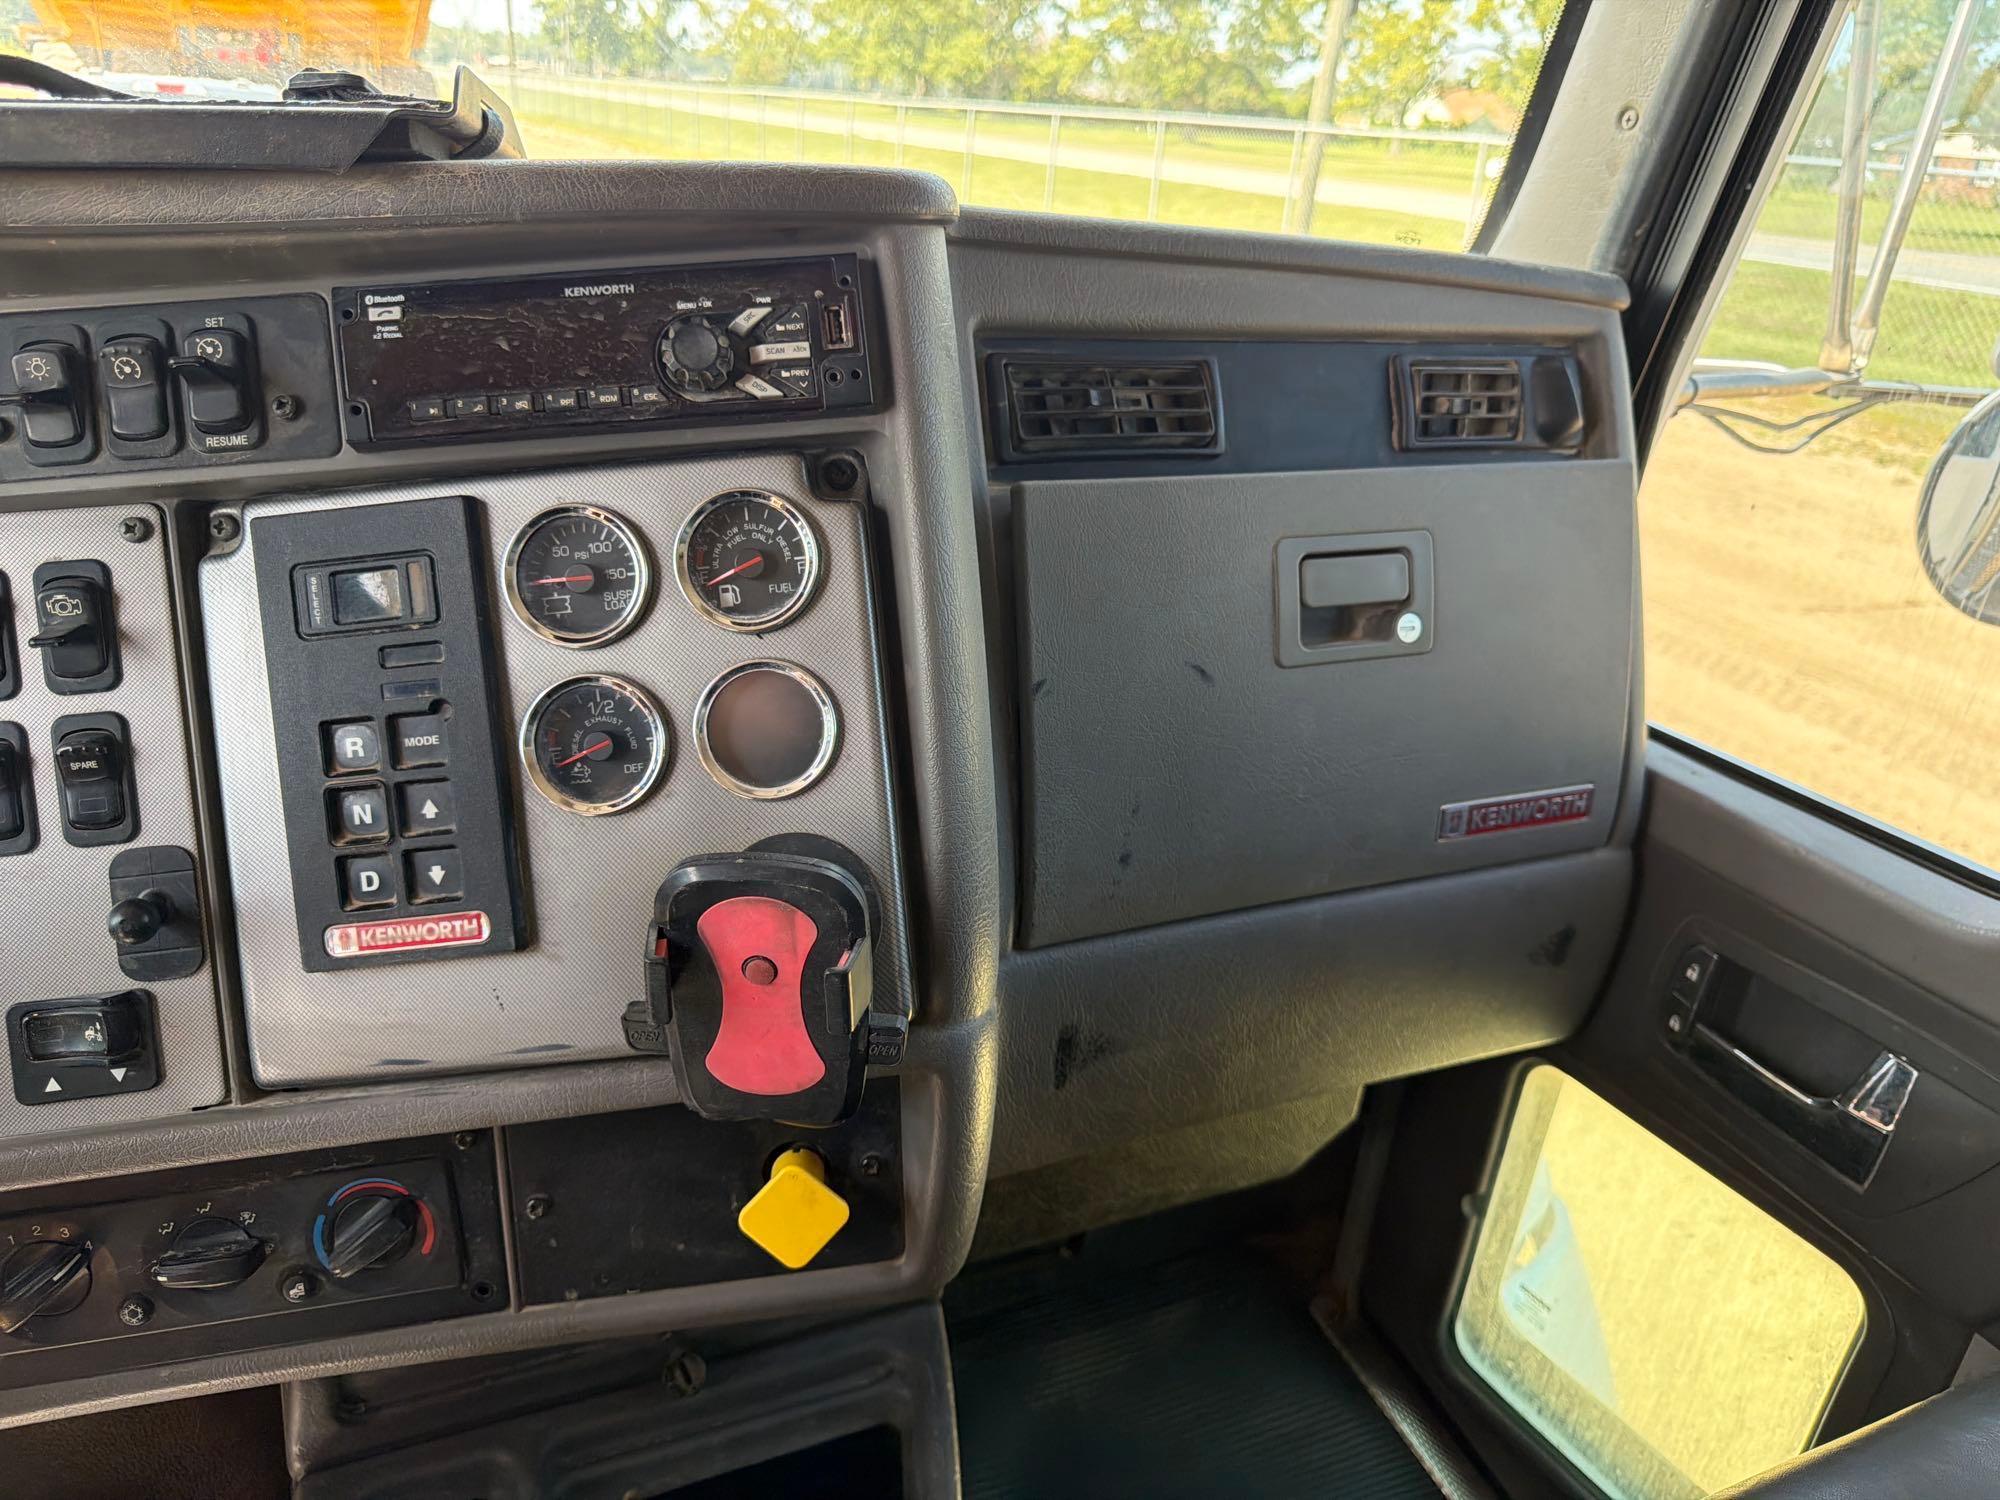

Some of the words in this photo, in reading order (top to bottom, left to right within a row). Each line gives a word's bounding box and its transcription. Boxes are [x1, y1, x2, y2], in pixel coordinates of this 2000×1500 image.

[564, 284, 635, 297] KENWORTH
[374, 294, 405, 304] Bluetooth
[676, 301, 697, 310] MENU
[204, 317, 225, 328] SET
[743, 312, 757, 323] SRC
[786, 323, 804, 331] NEXT
[766, 347, 785, 355] SCAN
[791, 369, 810, 377] PREV
[751, 381, 768, 393] DISP
[560, 398, 574, 406] RPT
[600, 395, 618, 403] RDM
[643, 392, 658, 400] ESC
[206, 435, 249, 447] RESUME
[712, 543, 723, 569] ULTRA
[722, 526, 739, 540] LOW
[743, 523, 774, 535] SULFUR
[775, 535, 792, 561] DIESEL
[727, 533, 747, 549] FUEL
[751, 532, 774, 545] ONLY
[552, 545, 570, 557] 50
[587, 541, 612, 554] 100
[574, 551, 590, 560] PSI
[768, 582, 796, 594] FUEL
[310, 576, 321, 625] SELECT
[603, 589, 634, 602] SUSP
[587, 700, 615, 716] 1/2
[404, 734, 440, 747] MODE
[571, 729, 585, 756] DIESEL
[584, 716, 623, 727] EXHAUST
[624, 726, 638, 750] FLUID
[345, 737, 365, 758] R
[69, 760, 98, 771] SPARE
[623, 763, 645, 774] DEF
[352, 803, 373, 825] N
[1471, 792, 1588, 829] KENWORTH
[359, 870, 380, 892] D
[360, 917, 479, 947] KENWORTH
[869, 1044, 899, 1056] OPEN
[7, 1235, 15, 1245] 1
[31, 1225, 42, 1236] 2
[60, 1227, 70, 1238] 3
[85, 1240, 94, 1251] 4
